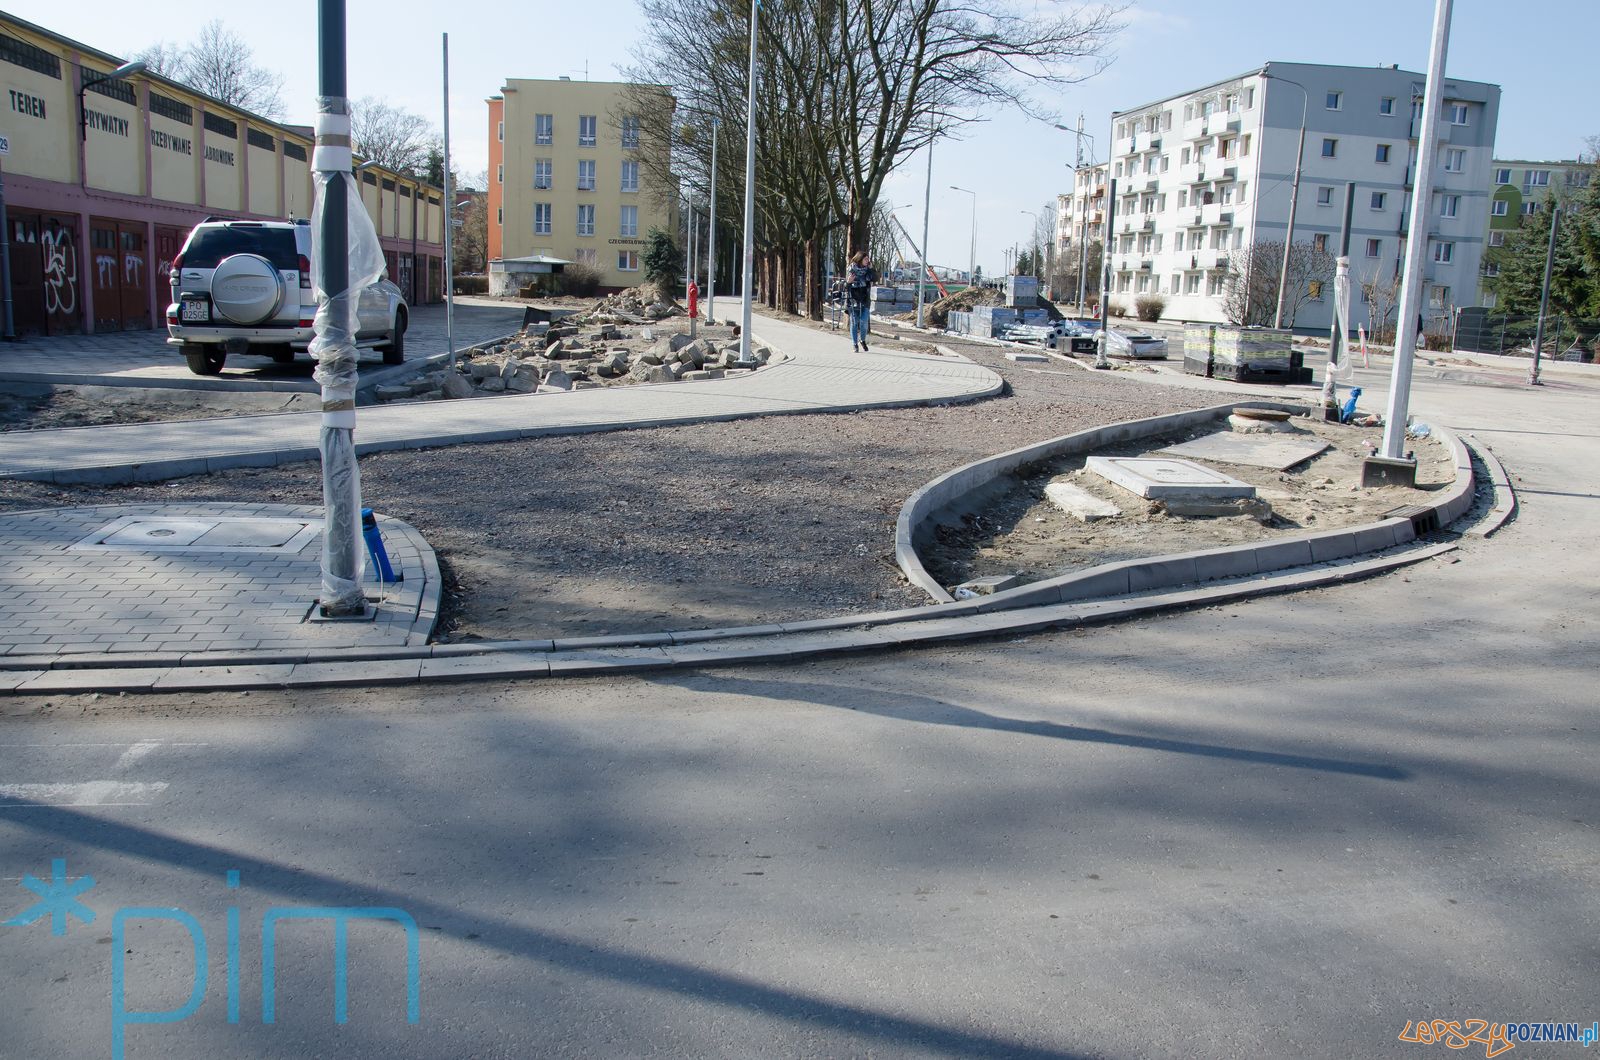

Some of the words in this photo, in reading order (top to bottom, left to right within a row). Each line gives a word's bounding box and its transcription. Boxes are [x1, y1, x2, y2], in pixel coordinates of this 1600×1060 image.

[9, 89, 46, 120] TEREN
[84, 108, 129, 137] PRYWATNY
[150, 129, 191, 156] RZEBYWANIE
[204, 145, 234, 167] ABRONIONE
